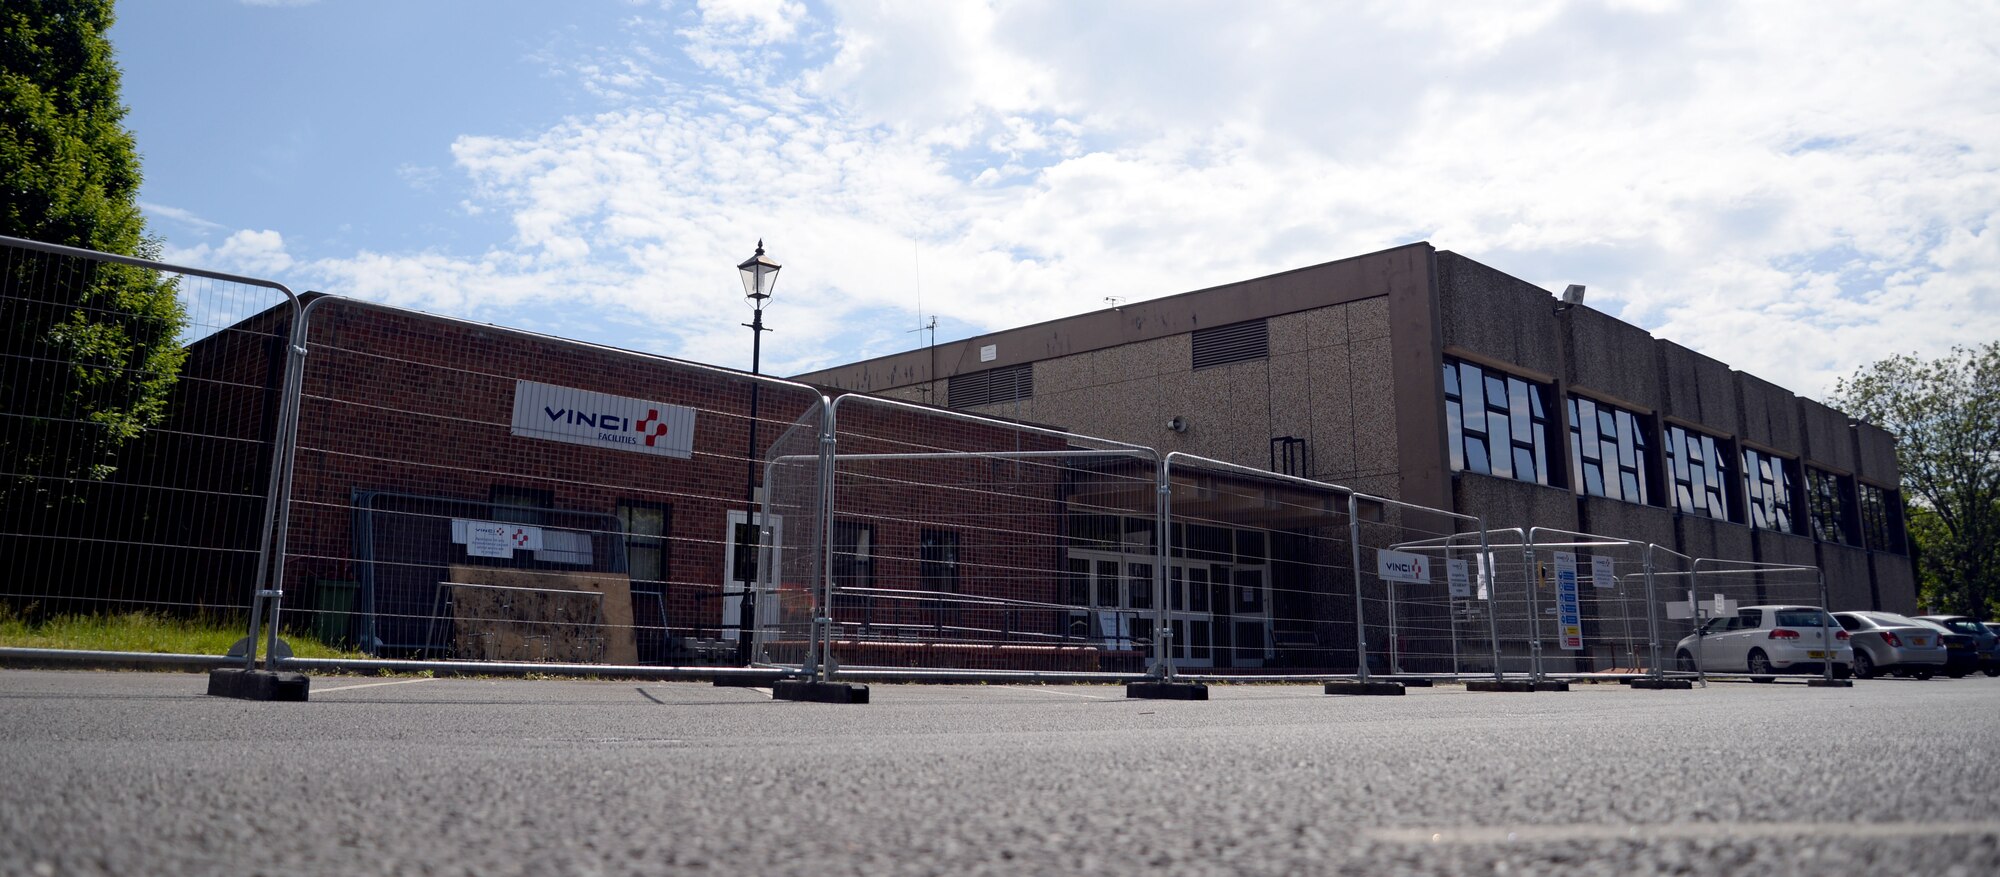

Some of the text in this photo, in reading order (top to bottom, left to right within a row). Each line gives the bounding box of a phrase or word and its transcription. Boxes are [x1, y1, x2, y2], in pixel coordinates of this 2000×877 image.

[544, 406, 628, 432] VINCI
[598, 433, 637, 445] FACILITIES
[1386, 562, 1410, 572] VINCI
